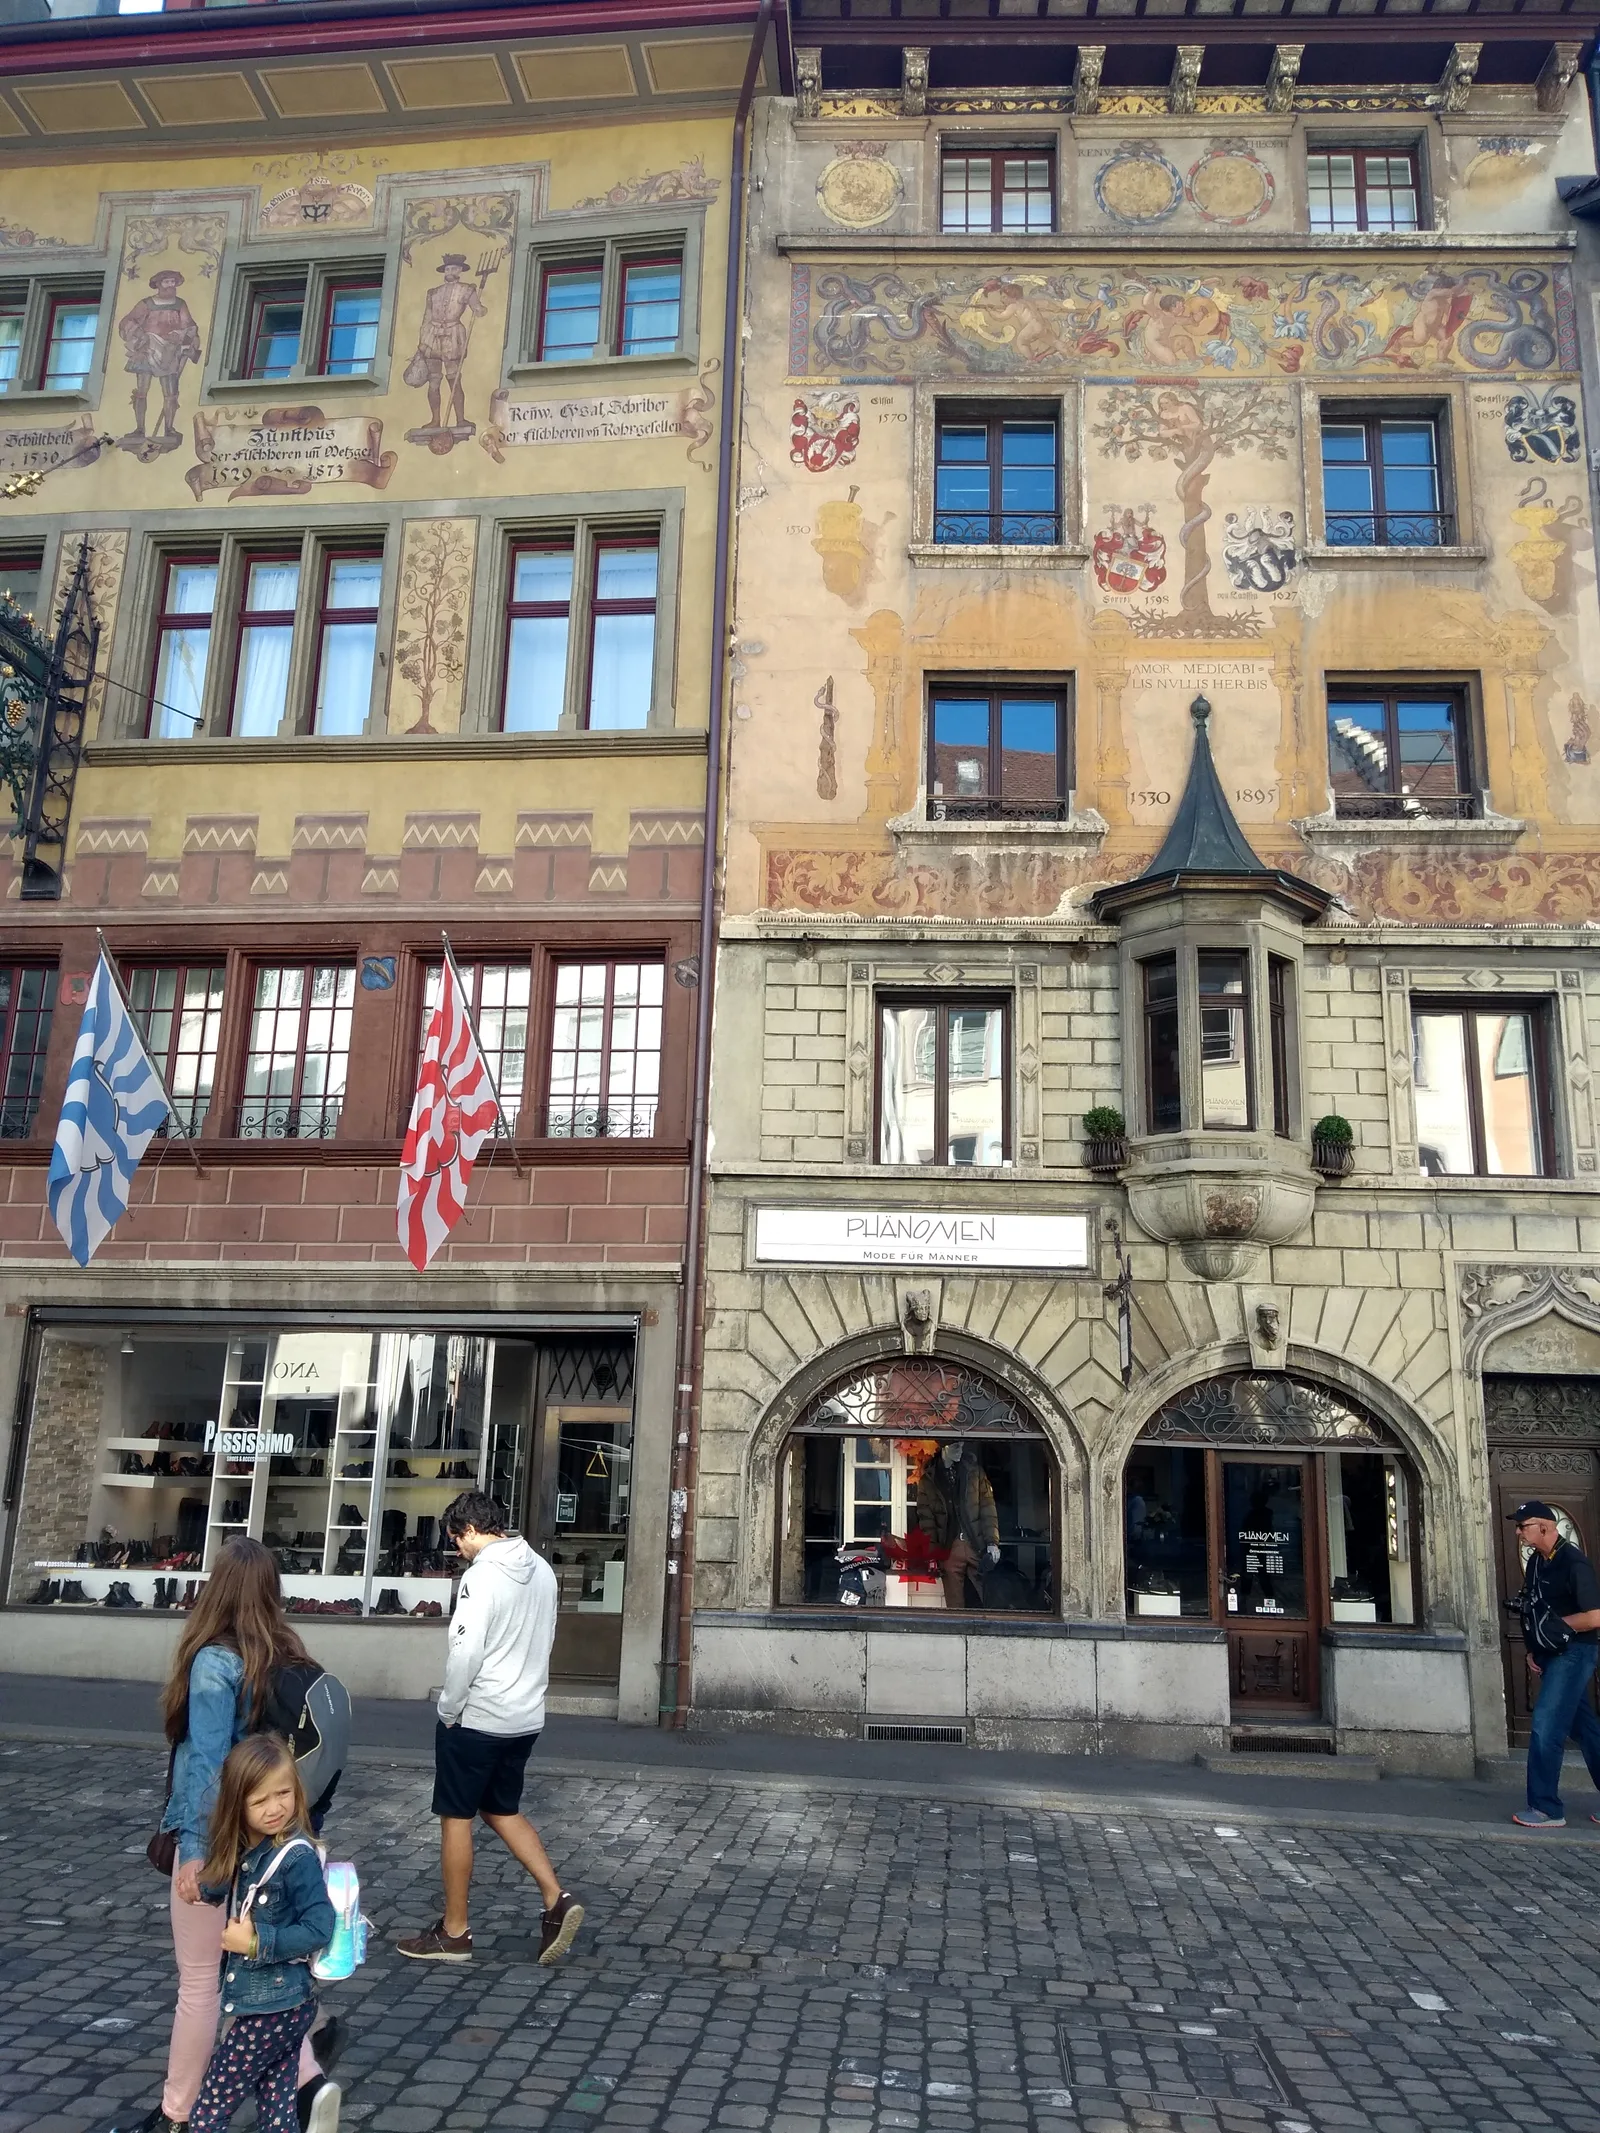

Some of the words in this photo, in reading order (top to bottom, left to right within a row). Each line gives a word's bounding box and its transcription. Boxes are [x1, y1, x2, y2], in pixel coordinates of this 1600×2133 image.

[879, 413, 908, 424] 1570
[303, 463, 344, 480] 1873
[1145, 595, 1169, 604] 1598
[1273, 591, 1298, 601] 1627
[1132, 663, 1172, 674] AMOR
[1132, 679, 1153, 689] LIS
[1157, 679, 1209, 690] NVLLIS
[1212, 679, 1268, 690] HERBIS
[1130, 791, 1171, 806] 1530
[1236, 788, 1276, 805] 1895
[847, 1214, 995, 1245] PHÄNOMEN
